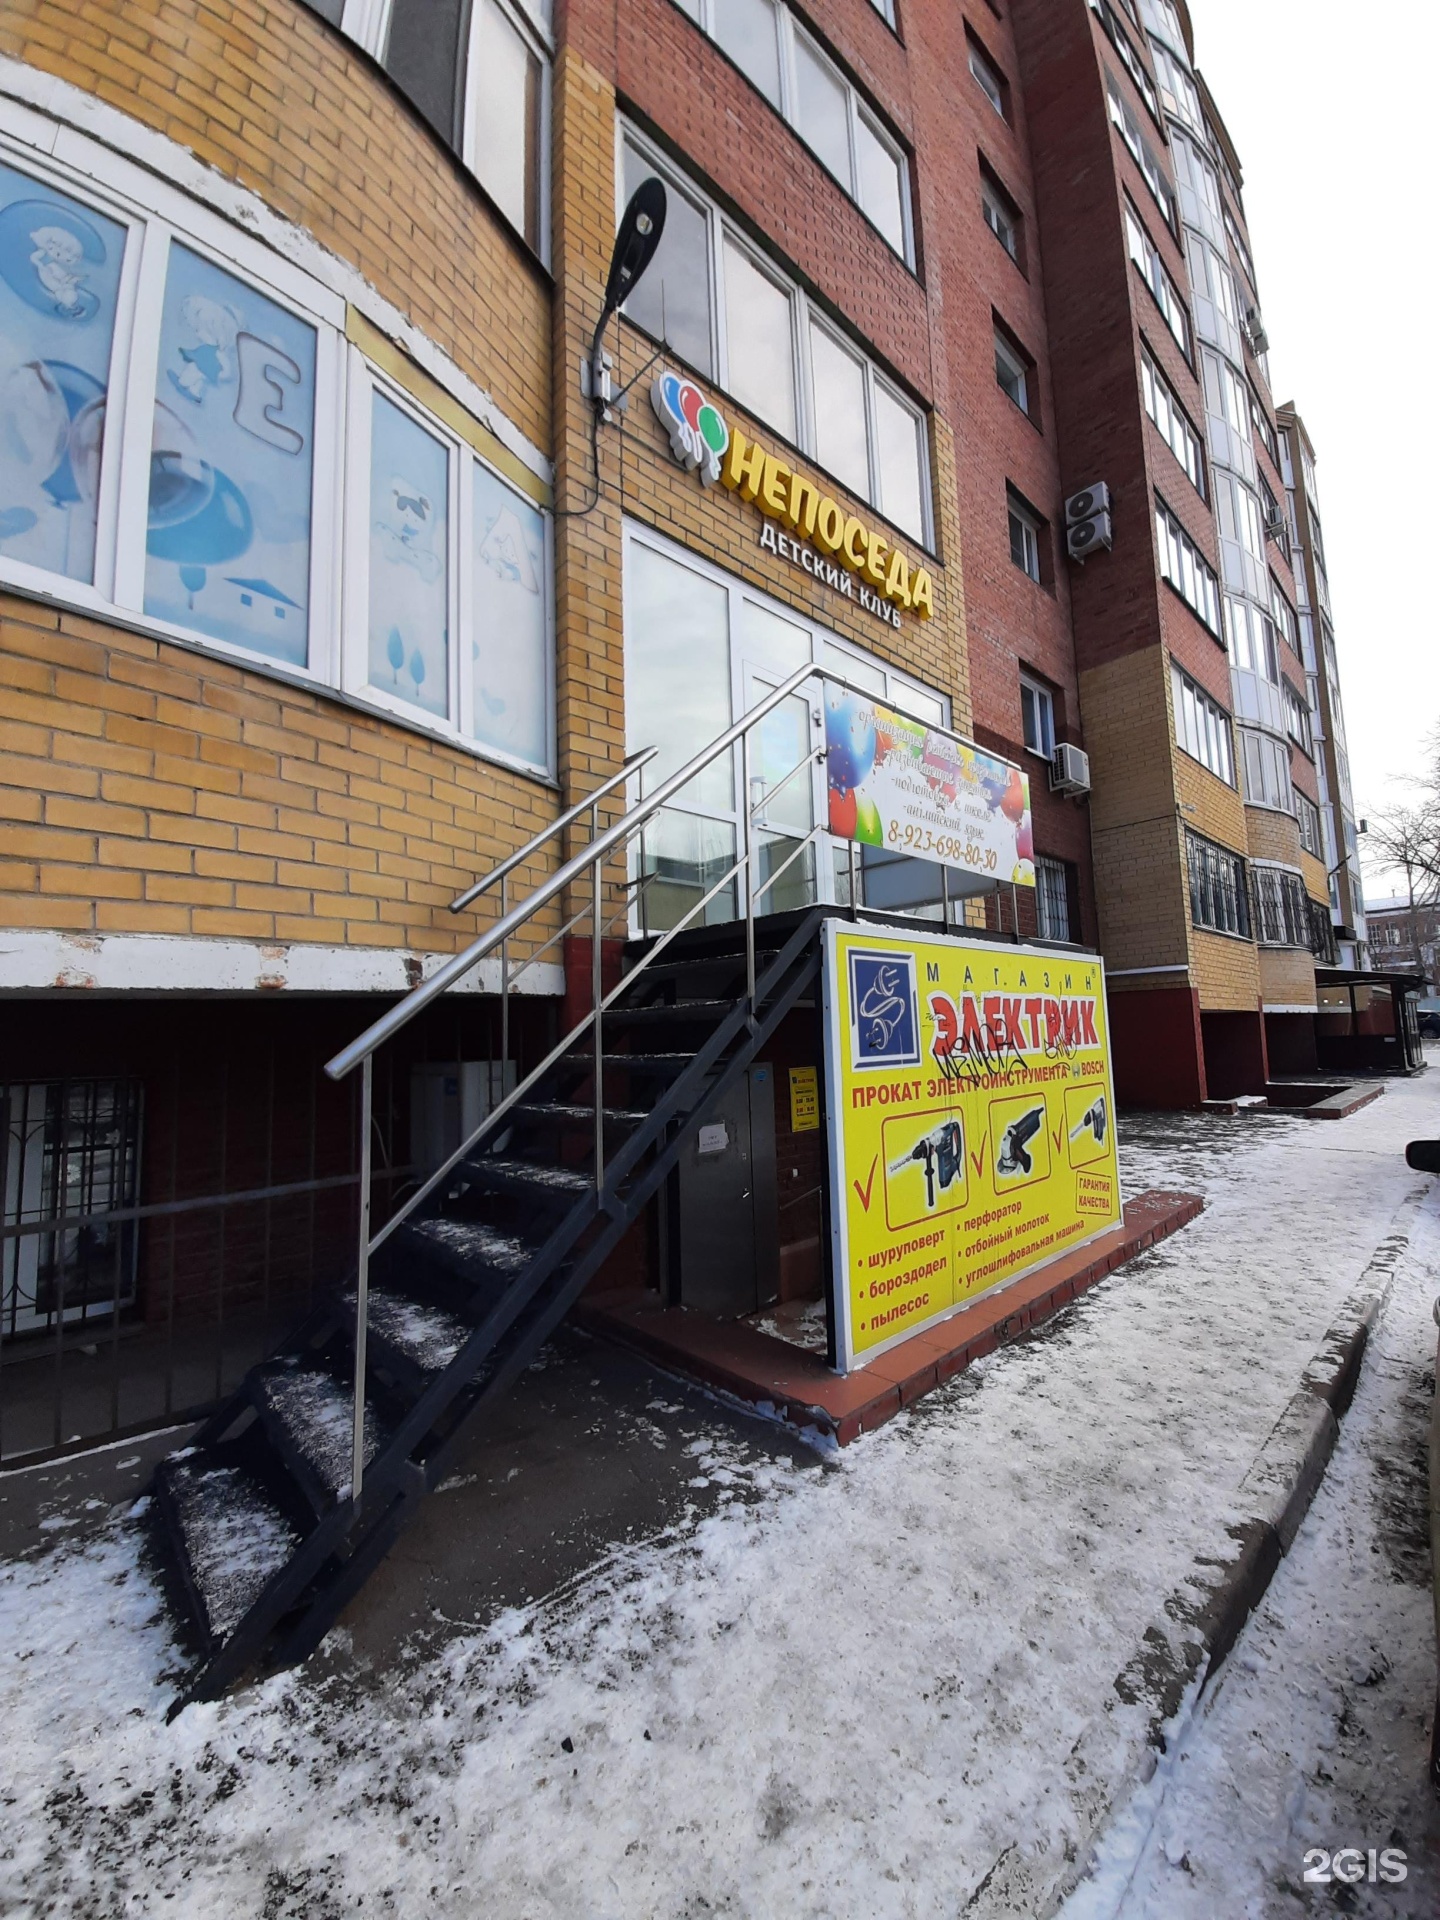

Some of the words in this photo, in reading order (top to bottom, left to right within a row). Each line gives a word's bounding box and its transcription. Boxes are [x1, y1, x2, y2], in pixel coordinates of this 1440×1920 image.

[722, 427, 934, 621] НЕПОСЕДА
[760, 523, 852, 598] ДЕТСКИЙ
[859, 586, 902, 628] КЛУБ
[888, 819, 998, 871] 8-923-698-80-30
[930, 996, 1099, 1057] ЭЛЕКТРИК
[852, 1080, 922, 1109] ПРОКАТ
[926, 1066, 1068, 1098] ЭЛЕКТРОИНСТРУМЕНТА
[1081, 1060, 1105, 1076] BOSCH
[1078, 1195, 1110, 1209] КАЧЕСТВА
[1079, 1177, 1110, 1192] ГАРАНТИЯ
[963, 1201, 1022, 1232] перфоратор
[965, 1226, 1013, 1258] отбойный
[1014, 1213, 1050, 1235] молоток
[868, 1229, 946, 1269] шуруповерт
[965, 1232, 1054, 1287] углошлифовальная
[1055, 1219, 1085, 1241] машина
[869, 1255, 948, 1299] бороздодел
[870, 1291, 930, 1330] пылесос
